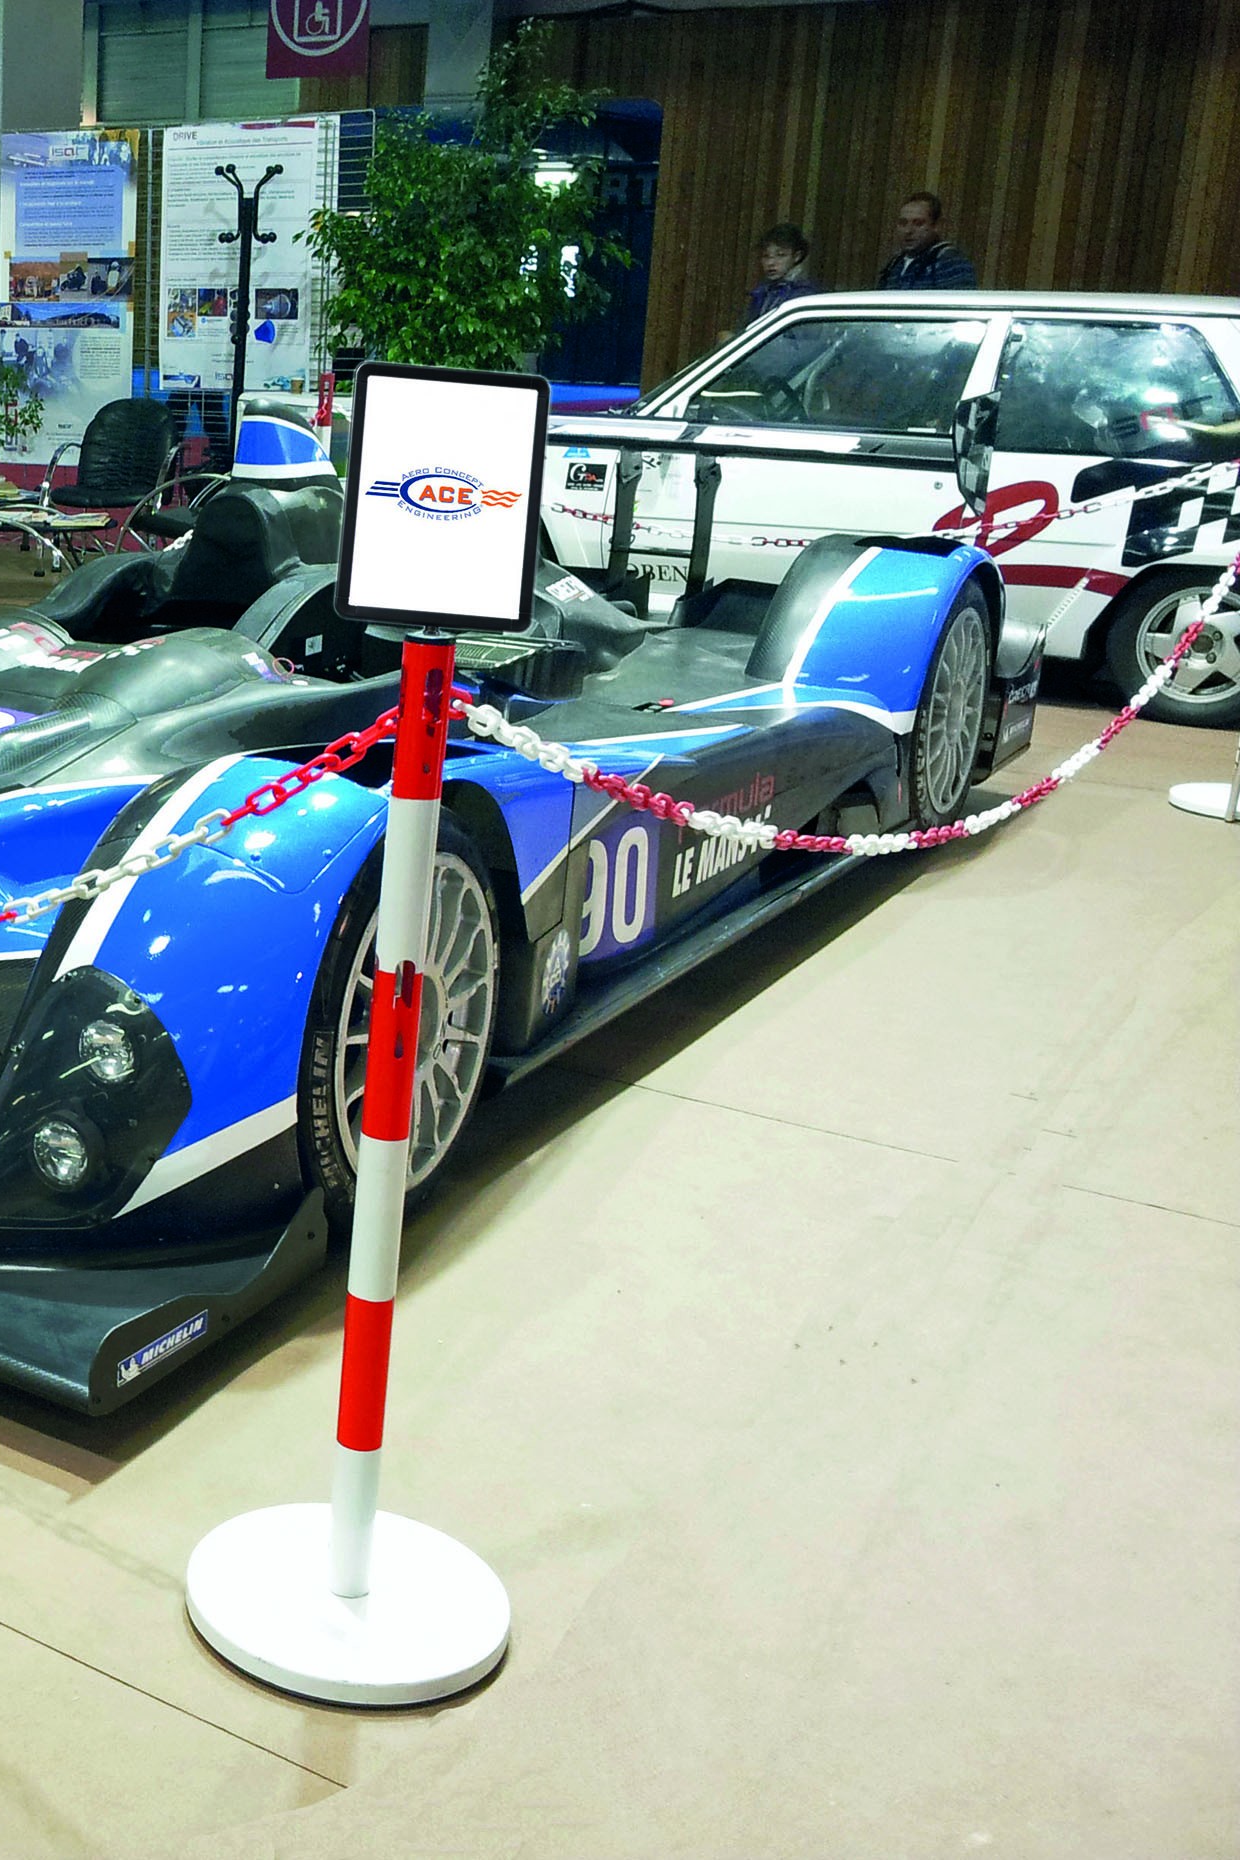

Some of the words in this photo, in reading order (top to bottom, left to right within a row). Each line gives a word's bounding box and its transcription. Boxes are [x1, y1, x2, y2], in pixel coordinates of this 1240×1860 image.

[173, 131, 198, 141] DRIVE
[401, 467, 430, 482] AERO
[434, 466, 485, 488] CONCEPT
[418, 484, 474, 505] ACE
[396, 499, 482, 521] ENGINEERING
[671, 846, 695, 898] LE
[578, 826, 649, 957] 90
[141, 1317, 204, 1365] MICHELIN
